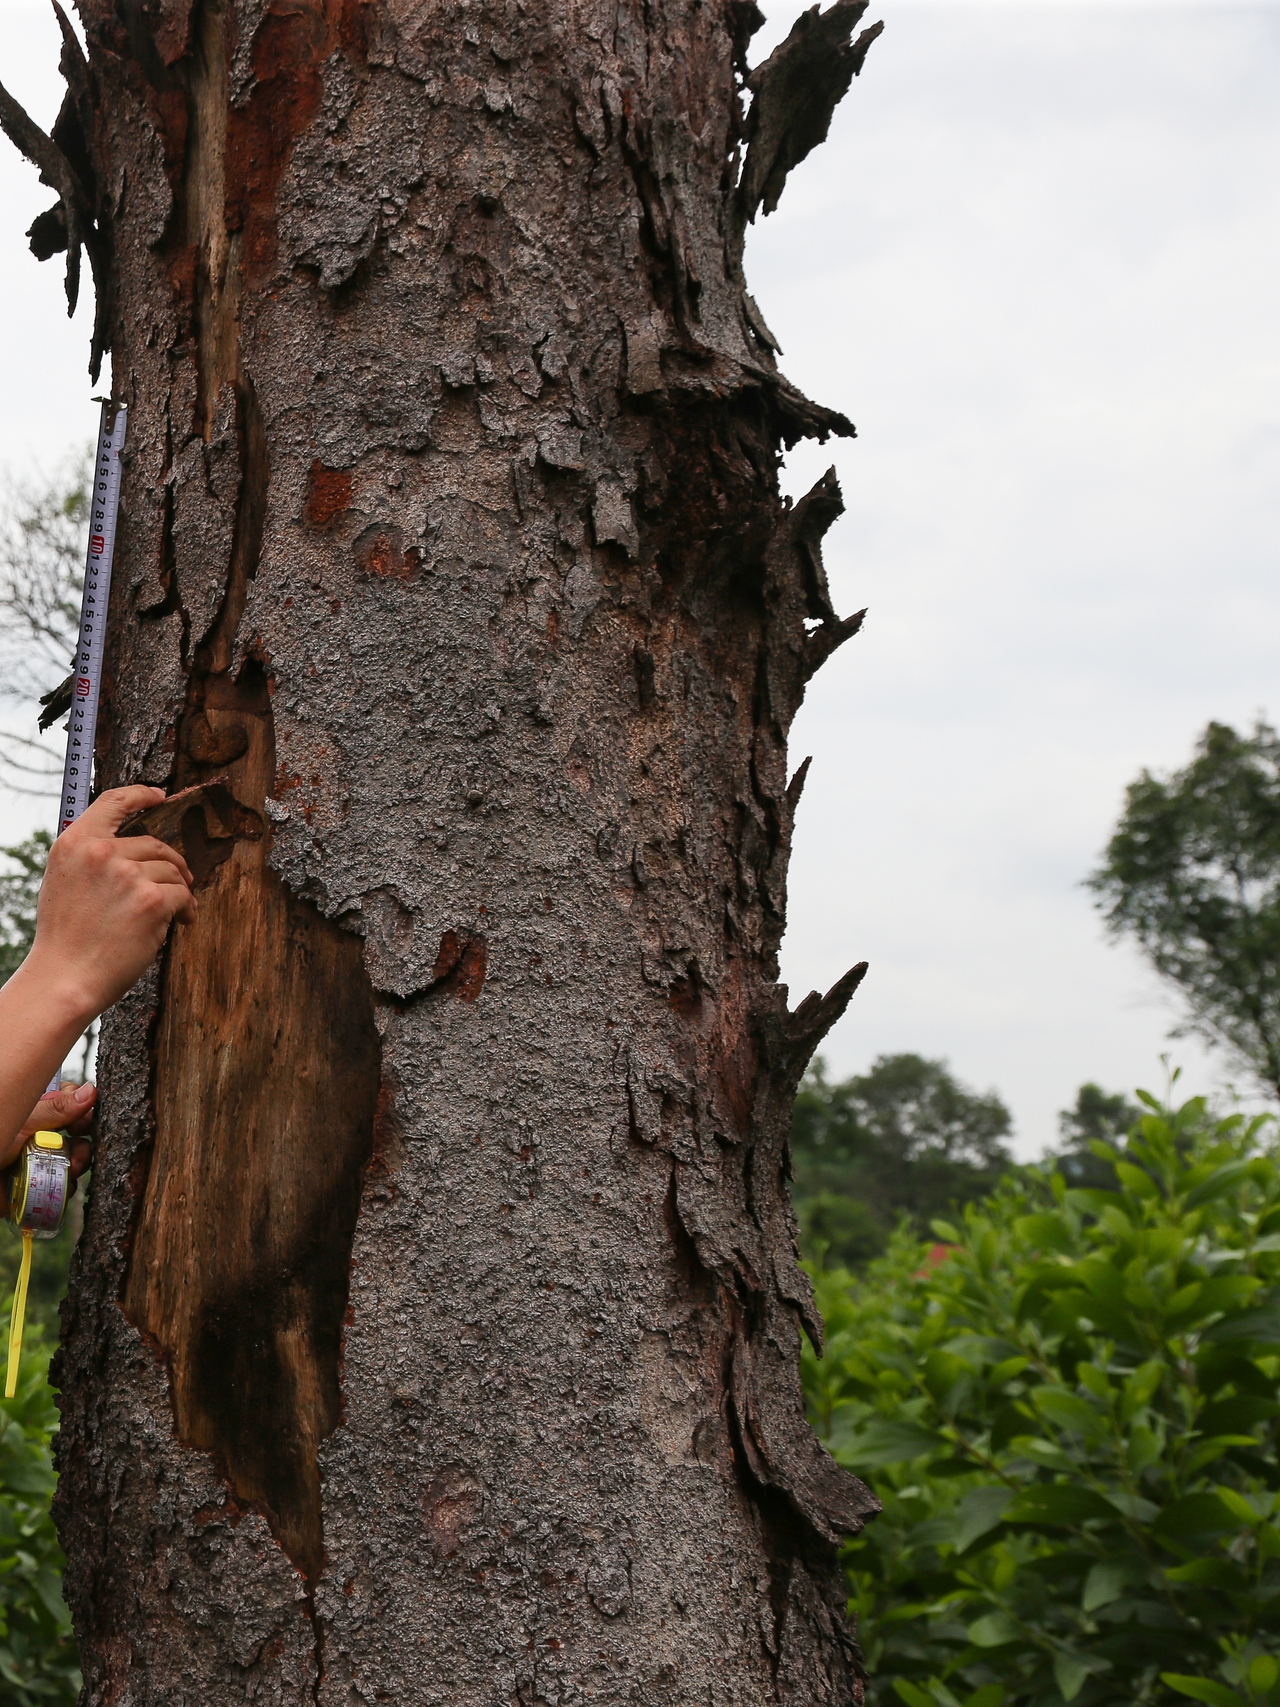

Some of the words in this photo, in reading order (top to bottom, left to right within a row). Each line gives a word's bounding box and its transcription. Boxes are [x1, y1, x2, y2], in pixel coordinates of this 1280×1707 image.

[102, 439, 111, 449] 3
[101, 454, 110, 462] 4
[100, 468, 108, 476] 5
[98, 482, 107, 490] 6
[97, 497, 106, 505] 7
[95, 510, 104, 519] 8
[94, 523, 103, 532] 9
[92, 539, 103, 553] 10
[89, 566, 98, 576] 2
[88, 581, 97, 590] 3
[87, 595, 95, 604] 4
[85, 610, 94, 618] 5
[84, 624, 93, 632] 6
[83, 639, 91, 647] 7
[81, 652, 90, 661] 8
[80, 665, 88, 674] 9
[77, 680, 89, 695] 20
[75, 709, 84, 718] 2
[74, 723, 83, 733] 3
[72, 738, 81, 747] 4
[71, 753, 80, 761] 5
[69, 767, 78, 776] 6
[68, 782, 77, 790] 7
[66, 795, 76, 804] 8
[65, 809, 74, 818] 9
